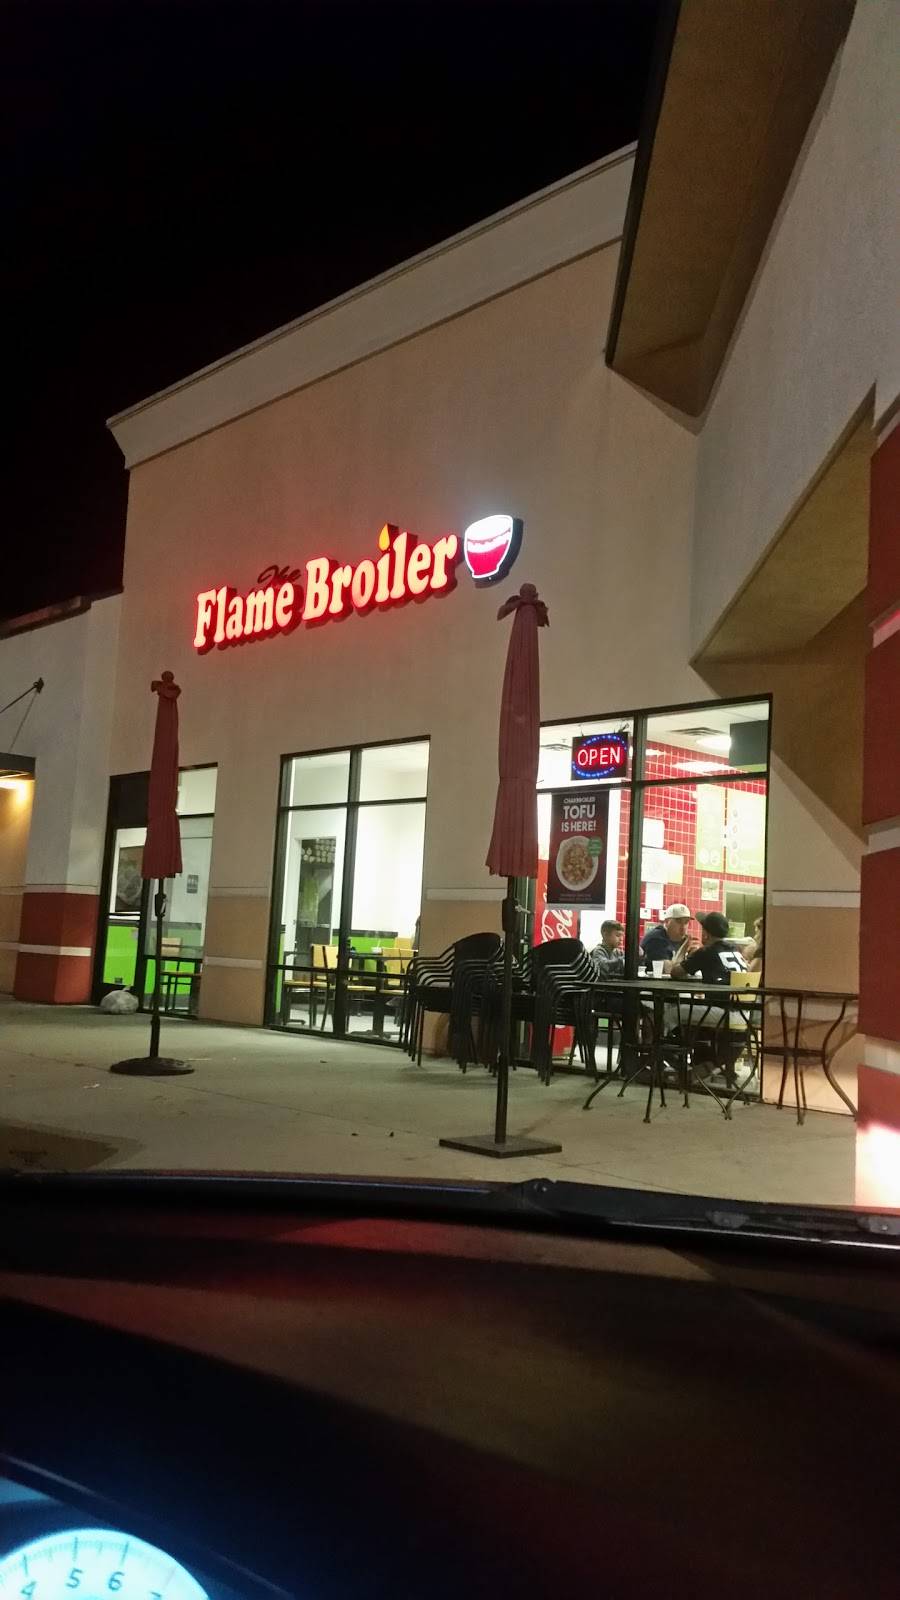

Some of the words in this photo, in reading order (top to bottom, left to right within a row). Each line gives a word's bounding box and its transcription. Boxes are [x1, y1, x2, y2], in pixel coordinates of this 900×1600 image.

[257, 564, 302, 583] The
[193, 582, 296, 648] Flame
[302, 524, 458, 620] Broiler
[577, 746, 621, 766] OPEN
[563, 804, 596, 820] TOFU
[561, 821, 570, 833] IS
[570, 820, 597, 832] HERE!
[718, 951, 748, 973] 5
[66, 1567, 83, 1589] 5
[108, 1571, 125, 1592] 6
[20, 1580, 37, 1600] 4
